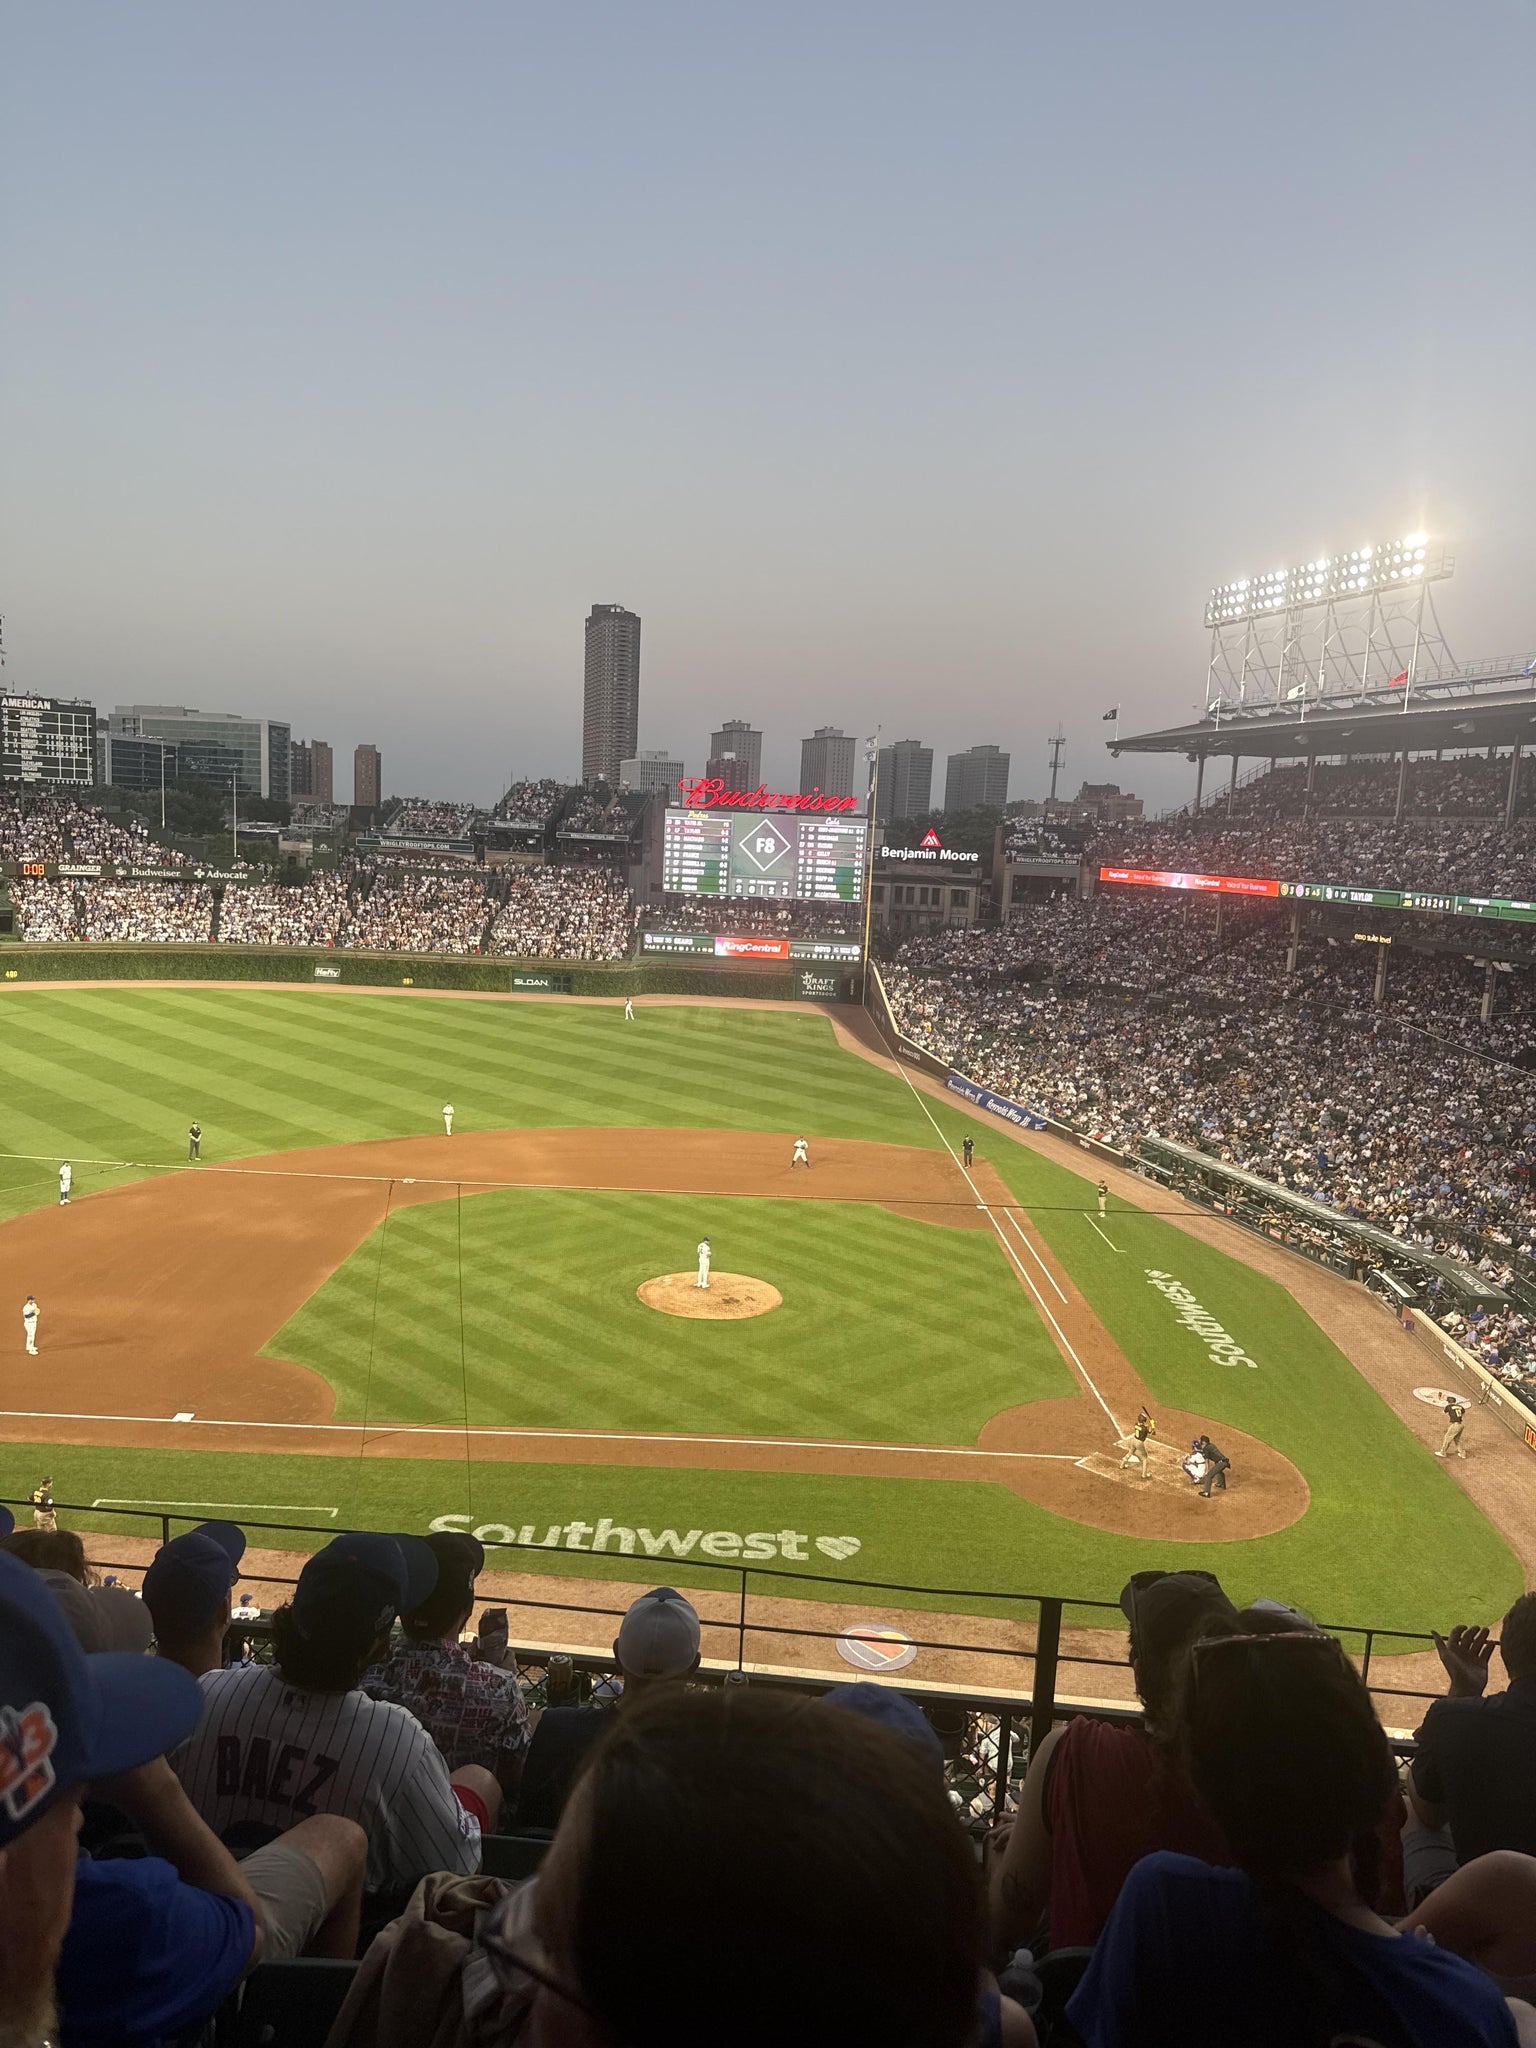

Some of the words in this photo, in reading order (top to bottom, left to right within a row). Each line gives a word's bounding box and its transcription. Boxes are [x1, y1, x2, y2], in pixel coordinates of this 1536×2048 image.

[1, 698, 51, 710] AMERICAN
[678, 778, 859, 812] Budweiser
[825, 817, 840, 825] Cubs
[380, 840, 450, 851] WRIGLEYROOFTOPS.COM
[756, 837, 776, 854] F8
[881, 846, 937, 861] Benjamin
[940, 848, 979, 862] Moore
[1016, 857, 1078, 866] WRIGLEYROOFTOPS.COM
[132, 868, 181, 877] Budweiser
[206, 871, 248, 880] Advocate
[1194, 878, 1221, 887] RingCentral
[1350, 891, 1374, 902] TAYLOR
[723, 941, 781, 954] RingCentral
[315, 968, 339, 977] Hefty
[986, 1099, 1008, 1117] Reynolds
[1007, 1107, 1022, 1123] Wrap
[1147, 1278, 1258, 1368] Southwest
[428, 1514, 810, 1560] Southwest
[216, 1735, 341, 1814] BAEZ
